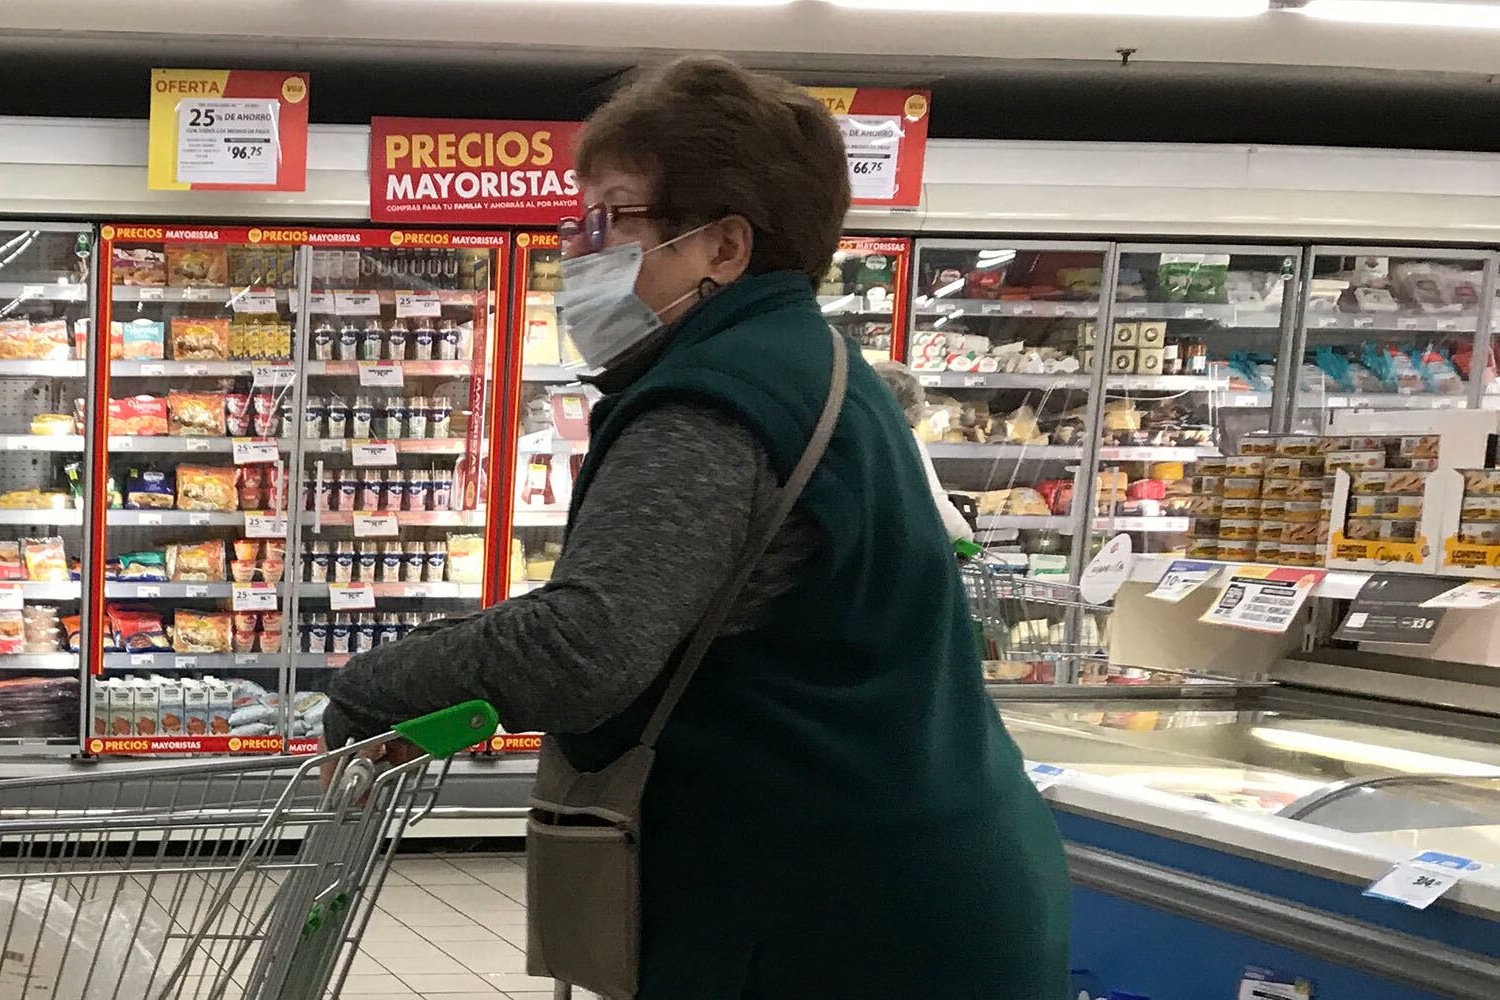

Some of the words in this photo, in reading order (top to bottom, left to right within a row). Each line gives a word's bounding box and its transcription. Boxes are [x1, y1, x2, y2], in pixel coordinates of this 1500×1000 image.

[155, 80, 220, 94] OFERTA
[224, 113, 236, 121] DE
[237, 113, 272, 121] AHORRO
[386, 130, 553, 169] PRECIOS
[386, 169, 580, 200] MAYORISTAS
[386, 204, 421, 212] COMPRAS
[422, 203, 441, 211] PARA
[453, 202, 483, 210] FAMILIA
[116, 227, 163, 239] PRECIOS
[165, 230, 219, 240] MAYORISTAS
[262, 231, 308, 242] PRECIOS
[308, 232, 361, 243] MAYORISTAS
[404, 233, 449, 244] PRECIOS
[452, 235, 504, 245] MAYORISTAS
[531, 234, 559, 245] PREC
[855, 241, 906, 252] MAYORISTAS
[105, 741, 149, 751] PRECIOS
[151, 741, 201, 750] MAYORISTAS
[289, 743, 318, 752] MAYOR
[505, 738, 542, 748] PRECIO
